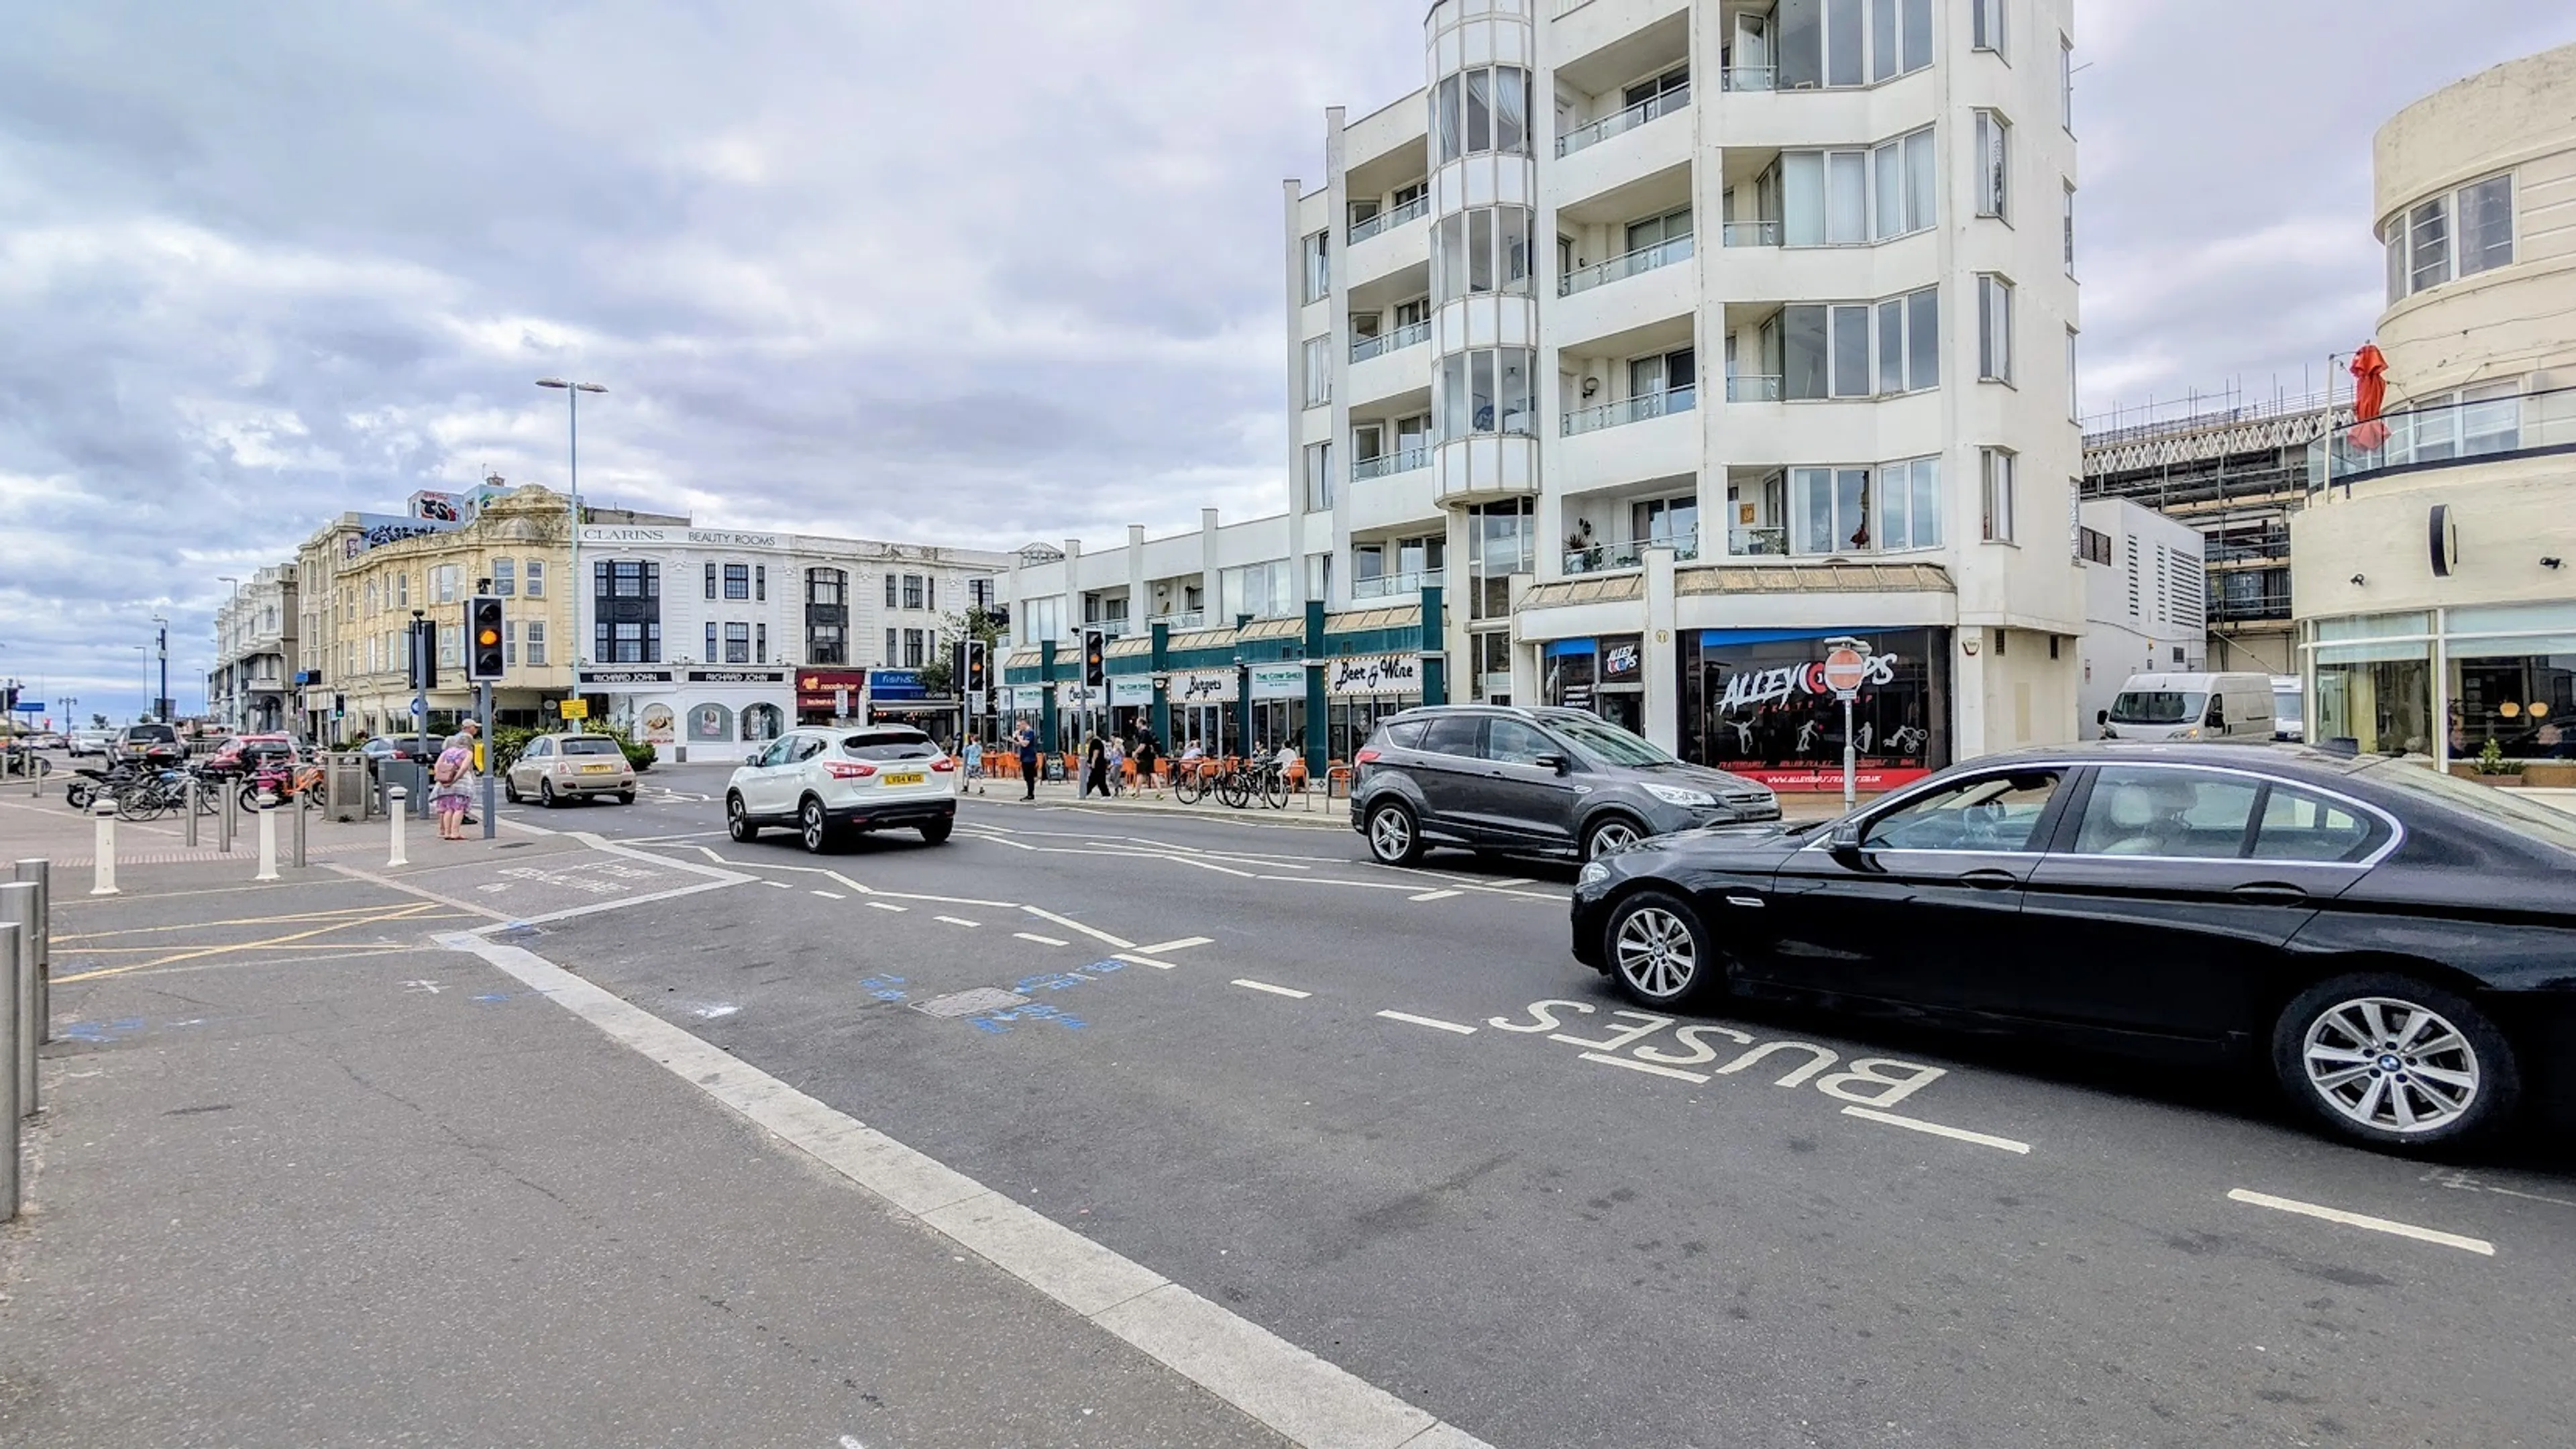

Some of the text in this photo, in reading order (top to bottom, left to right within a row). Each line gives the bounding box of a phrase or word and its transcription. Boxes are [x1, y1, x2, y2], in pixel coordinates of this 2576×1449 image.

[584, 529, 775, 546] CLARINS BEAUTY ROOMS
[593, 674, 631, 682] RICHARD
[706, 674, 769, 682] RICHARD JOHN
[1334, 661, 1366, 691] Beer
[1380, 658, 1413, 679] Wine
[1715, 653, 1898, 715] ALLEYOPS
[1185, 675, 1222, 698] Burgers
[1758, 700, 1813, 714] SKATE
[1488, 999, 1949, 1108] BUSES
